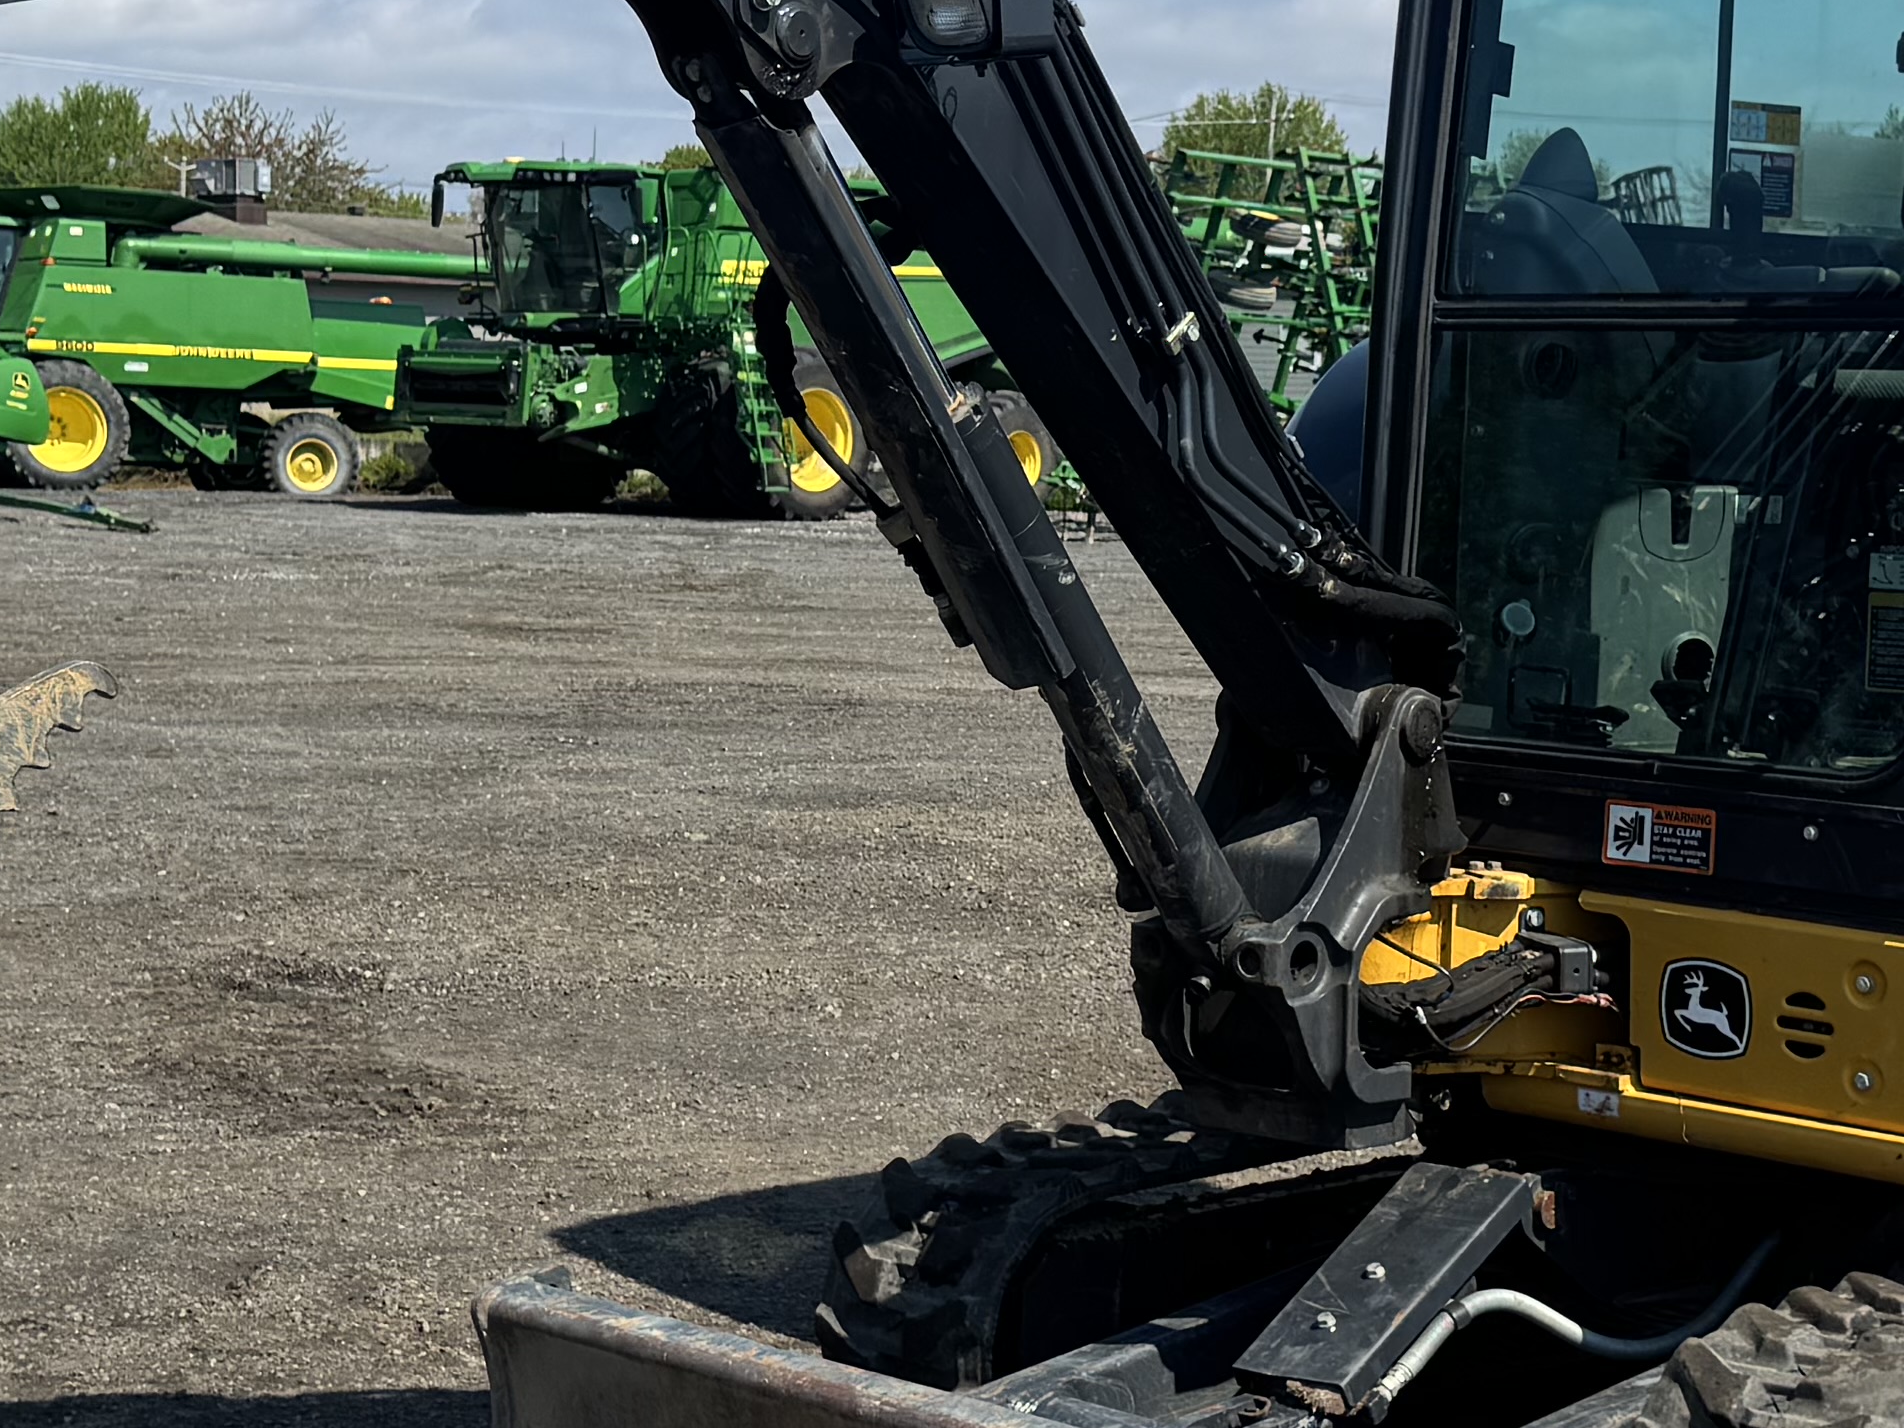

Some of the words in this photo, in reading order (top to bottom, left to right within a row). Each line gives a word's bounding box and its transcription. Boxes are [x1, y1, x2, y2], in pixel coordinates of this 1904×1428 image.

[1664, 811, 1712, 826] WARNING
[1653, 825, 1674, 835] STAY
[1676, 828, 1702, 838] CLEAR
